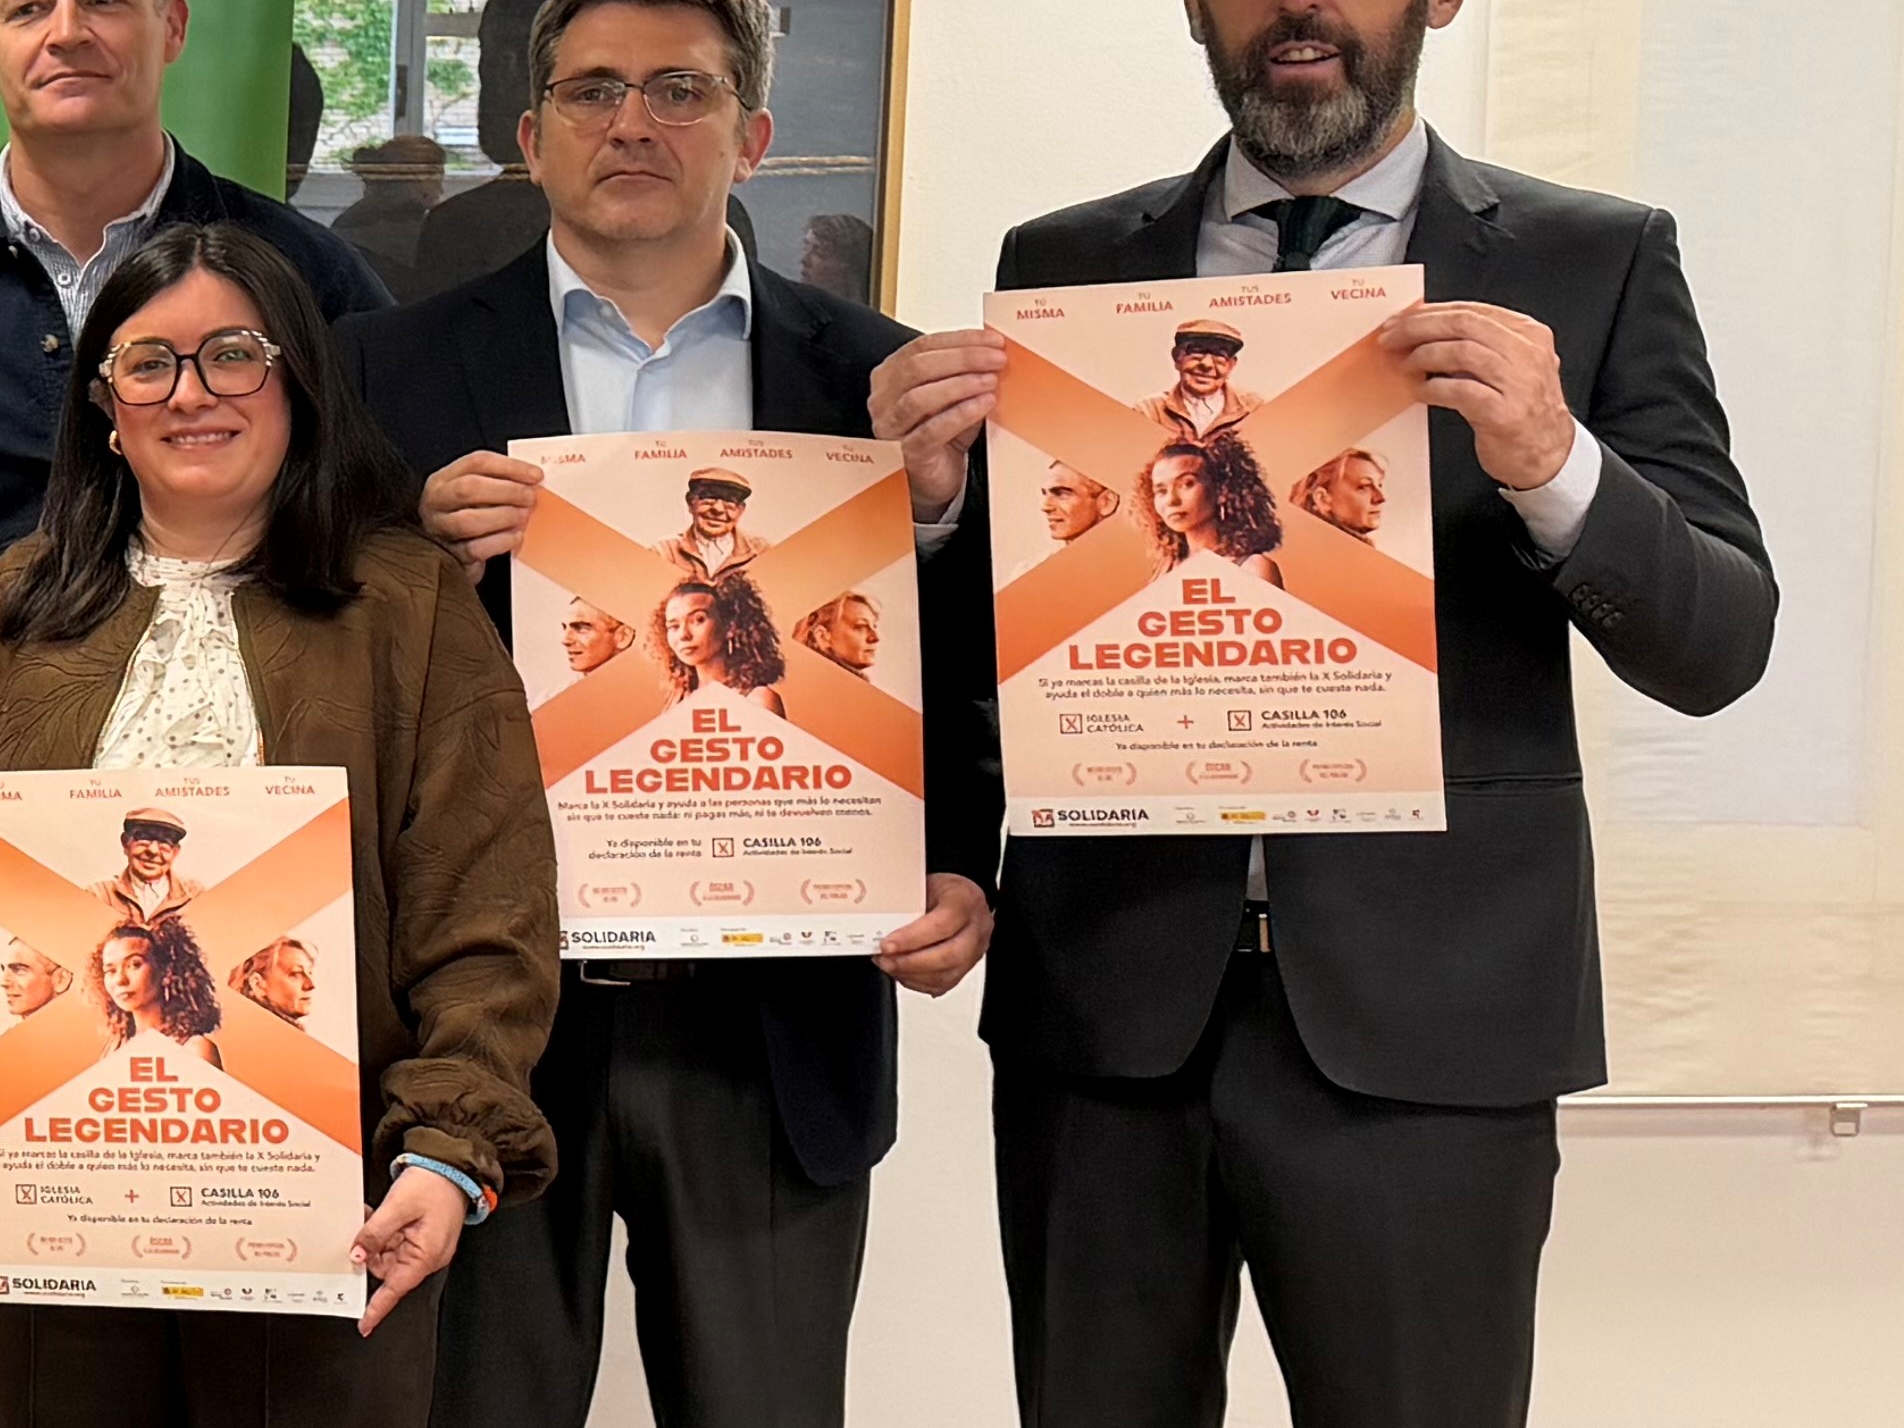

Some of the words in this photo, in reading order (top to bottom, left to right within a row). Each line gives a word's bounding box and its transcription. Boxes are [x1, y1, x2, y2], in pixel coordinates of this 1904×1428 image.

[1115, 300, 1173, 314] FAMILIA
[1208, 293, 1292, 308] AMISTADES
[1331, 287, 1386, 300] VECINA
[1183, 578, 1234, 603] EL
[1138, 608, 1281, 636] GESTO
[1070, 637, 1356, 670] LEGENDARIO
[693, 709, 739, 731] EL
[1260, 709, 1319, 720] CASILLA
[1323, 708, 1346, 719] 106
[650, 737, 783, 761] GESTO
[585, 765, 851, 793] LEGENDARIO
[69, 788, 121, 799] FAMILIA
[1057, 809, 1148, 822] SOLIDARIA
[743, 837, 796, 847] CASILLA
[800, 836, 821, 846] 106
[570, 931, 656, 944] SOLIDARIA
[130, 1058, 176, 1080] EL
[89, 1088, 220, 1112] GESTO
[26, 1118, 289, 1144] LEGENDARIO
[200, 1187, 254, 1198] CASILLA
[257, 1188, 279, 1198] 106
[12, 1278, 96, 1292] SOLIDARIA
